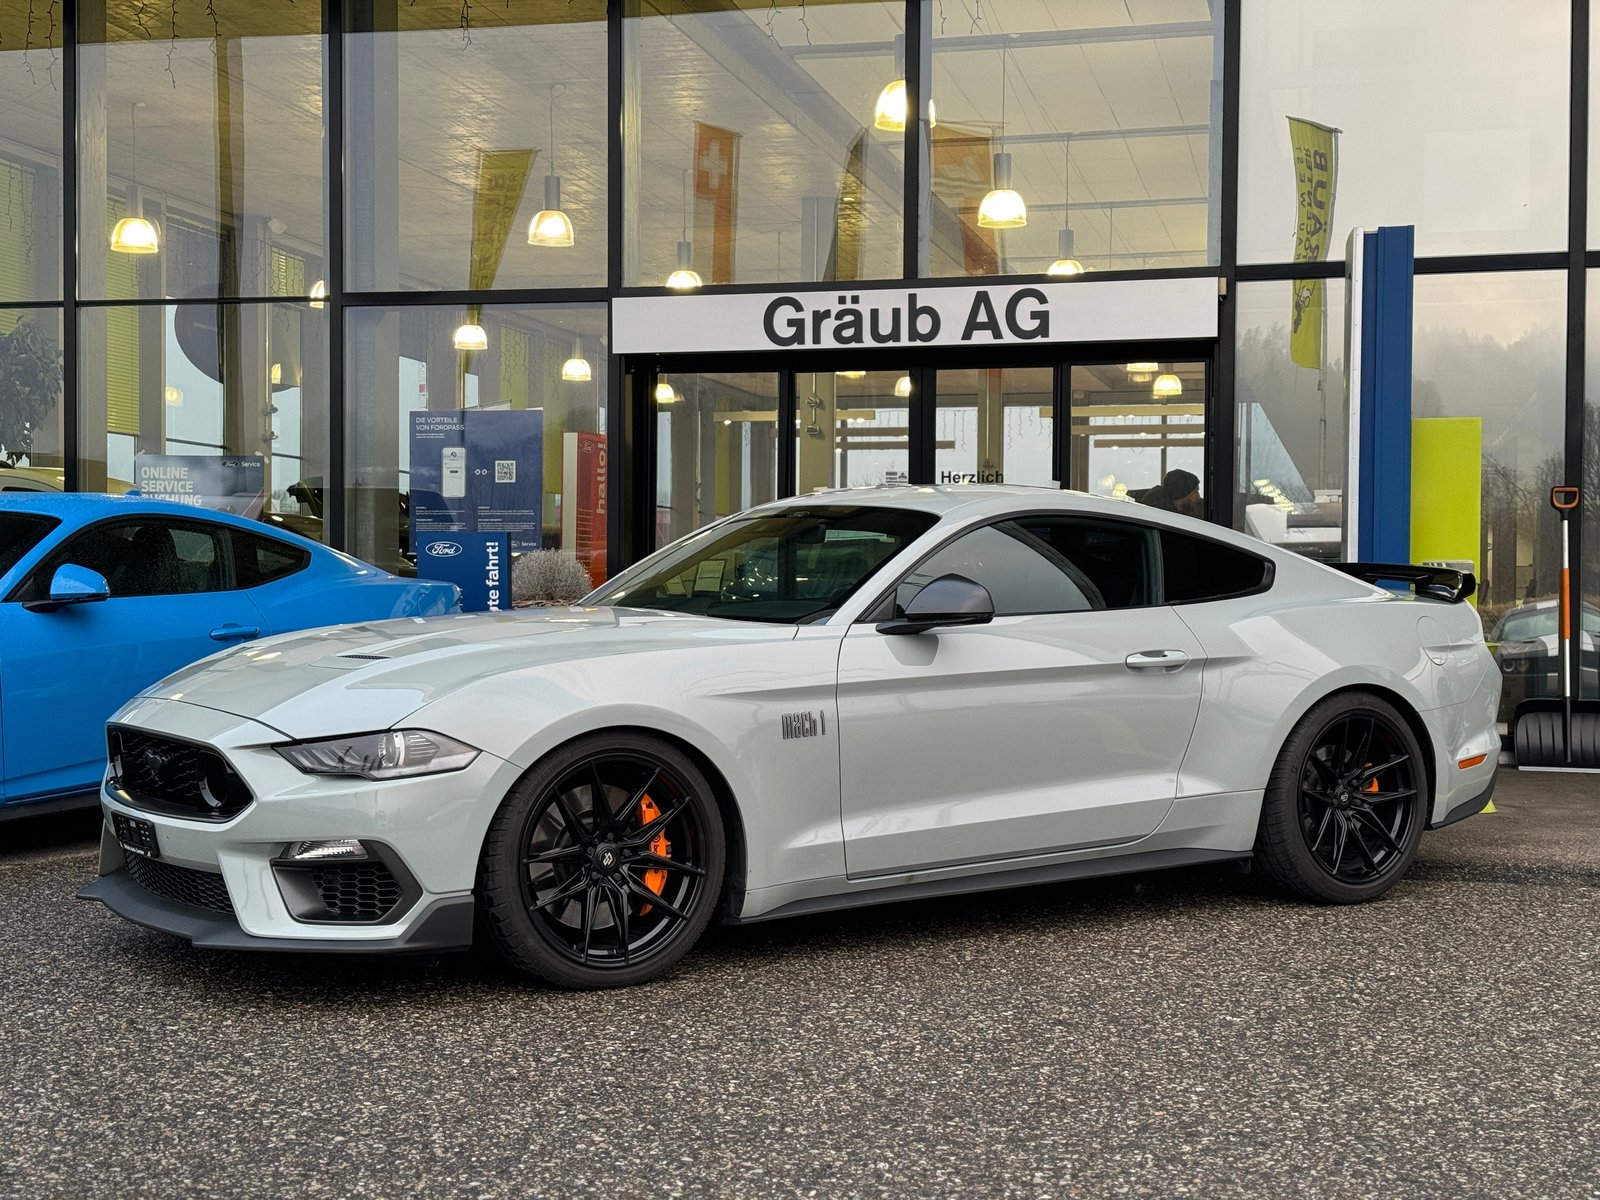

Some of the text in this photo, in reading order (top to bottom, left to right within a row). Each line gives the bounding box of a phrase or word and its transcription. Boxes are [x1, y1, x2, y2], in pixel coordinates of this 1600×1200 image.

[763, 287, 1051, 346] Gräub AG
[141, 467, 188, 479] ONLINE
[596, 442, 606, 514] hallo!
[941, 470, 1004, 484] Herzlich
[141, 480, 194, 493] SERVICE
[430, 543, 458, 556] Ford
[485, 541, 499, 587] fahrt!
